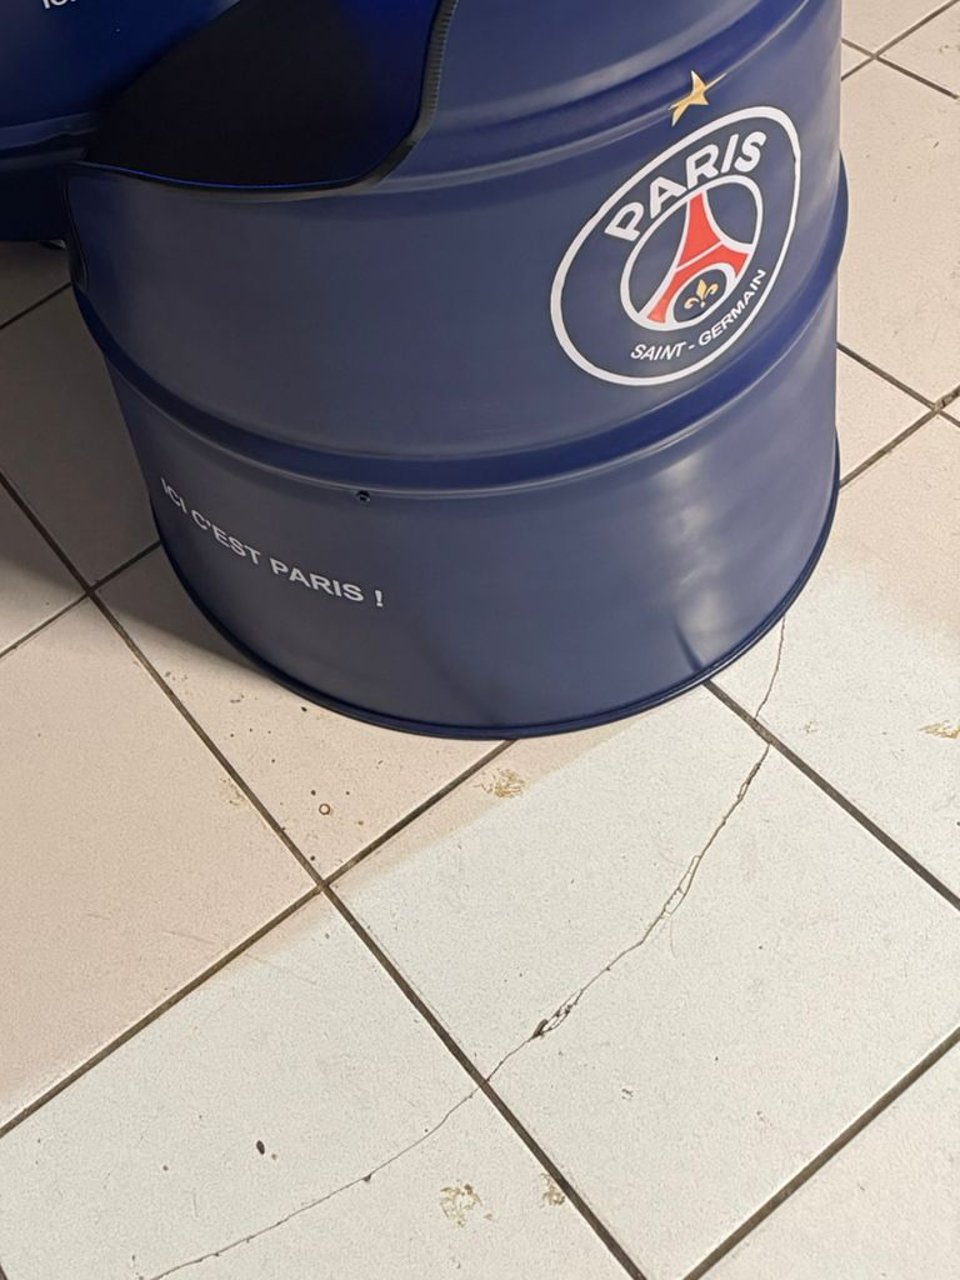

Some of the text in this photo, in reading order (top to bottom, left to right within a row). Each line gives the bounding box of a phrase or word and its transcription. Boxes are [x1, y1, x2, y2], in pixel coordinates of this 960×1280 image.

[604, 131, 767, 242] PARIS
[698, 269, 767, 346] GERMAIN
[161, 477, 188, 514] ICI
[191, 509, 261, 565] C'EST
[269, 557, 364, 602] PARIS
